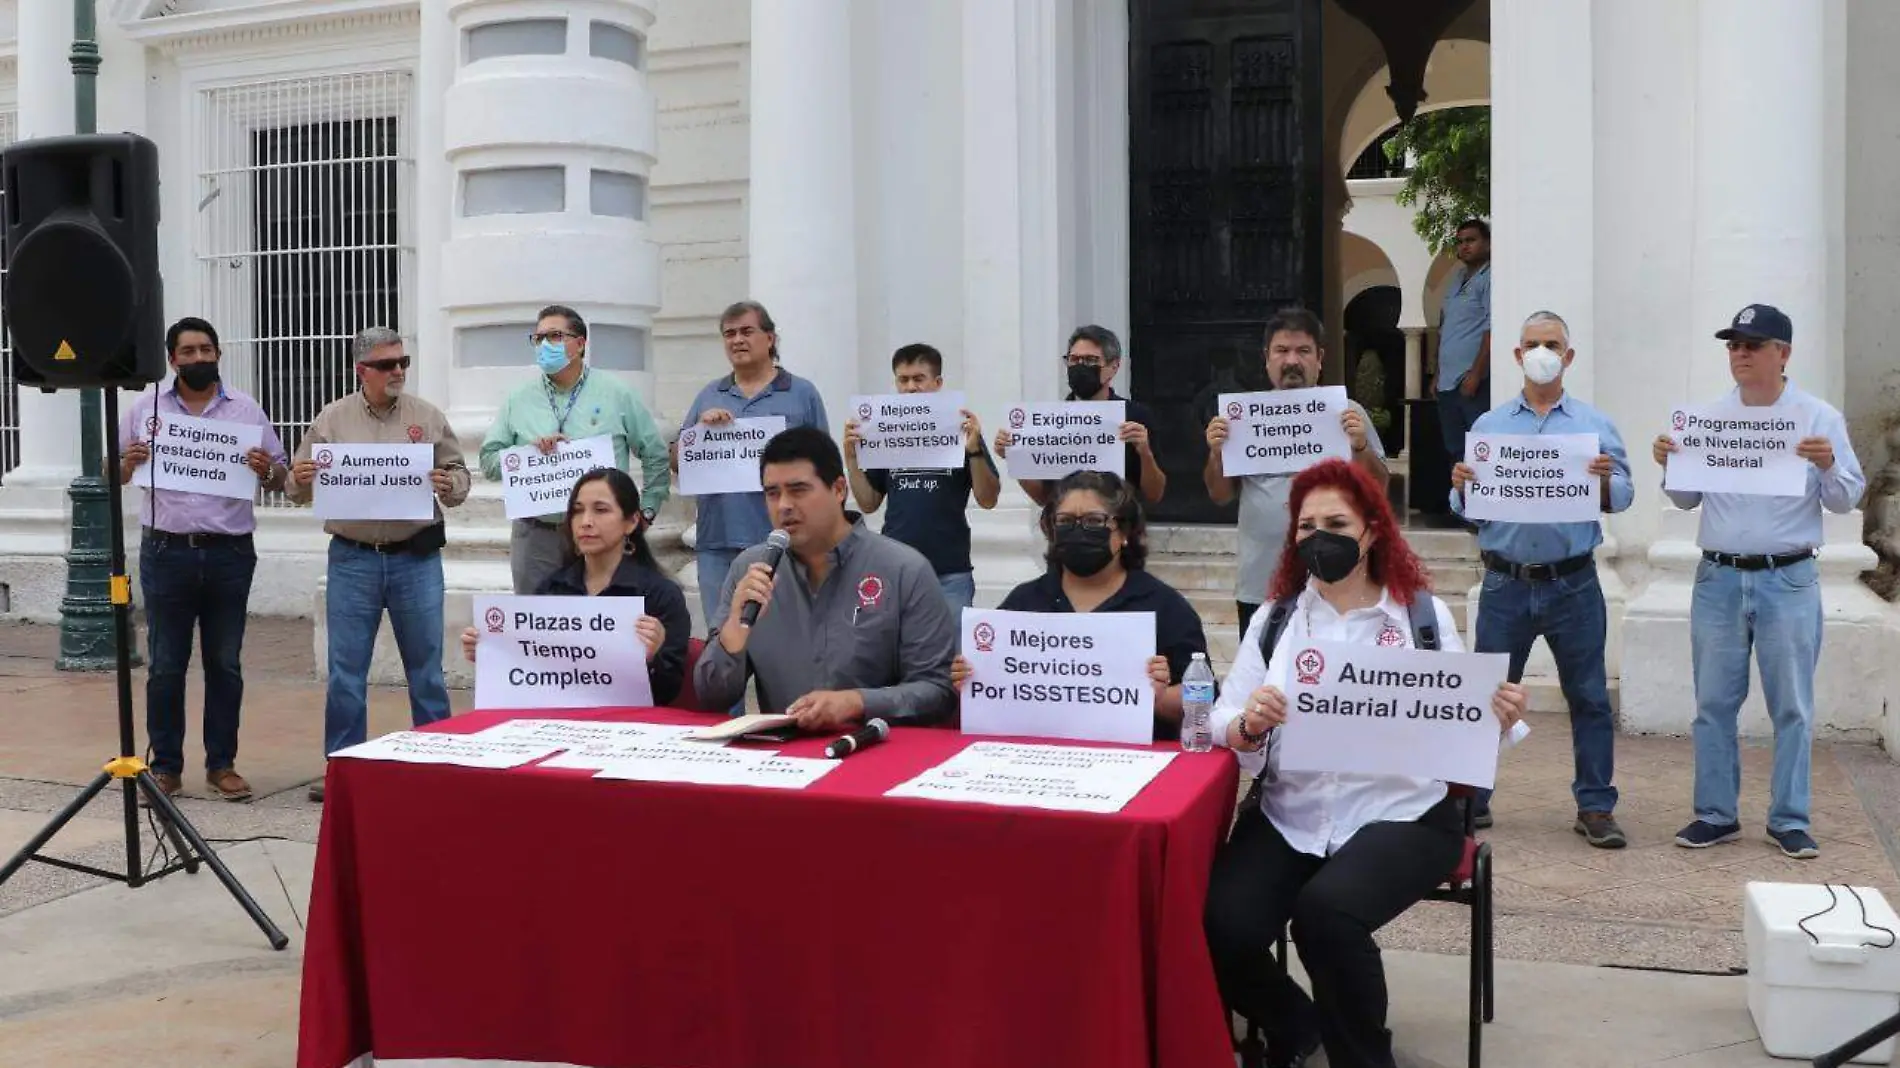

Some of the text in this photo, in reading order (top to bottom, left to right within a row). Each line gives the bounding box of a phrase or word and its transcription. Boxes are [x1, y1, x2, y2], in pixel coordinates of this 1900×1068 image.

[881, 404, 931, 417] Mejores
[1249, 400, 1326, 417] Plazas de
[878, 420, 936, 433] Servicios
[1032, 412, 1102, 429] Exigimos
[1688, 415, 1795, 432] Programación
[168, 423, 238, 446] Exigimos
[703, 429, 765, 442] Aumento
[1252, 423, 1312, 437] Tiempo
[860, 434, 958, 449] Por ISSSTESON
[1012, 432, 1116, 446] Prestación de
[1682, 435, 1785, 450] de Nivelación
[527, 449, 592, 467] Exigimos
[684, 447, 765, 462] Salarial Jus
[1031, 452, 1096, 464] Vivienda
[1246, 441, 1323, 458] Completo
[1500, 446, 1559, 461] Mejores
[341, 454, 410, 467] Aumento
[1706, 454, 1763, 468] Salarial
[162, 461, 226, 481] Vivienda
[320, 472, 423, 486] Salarial Justo
[509, 467, 584, 487] Prestación
[1495, 465, 1564, 479] Servicios
[1471, 483, 1589, 498] Por ISSSTESON
[514, 612, 616, 631] Plazas de
[1010, 629, 1094, 651] Mejores
[518, 640, 596, 661] Tiempo
[1004, 656, 1103, 676] Servicios
[508, 668, 613, 689] Completo
[1338, 662, 1462, 689] Aumento
[971, 682, 1139, 705] Por ISSSTESON
[1297, 692, 1482, 722] Salarial Justo
